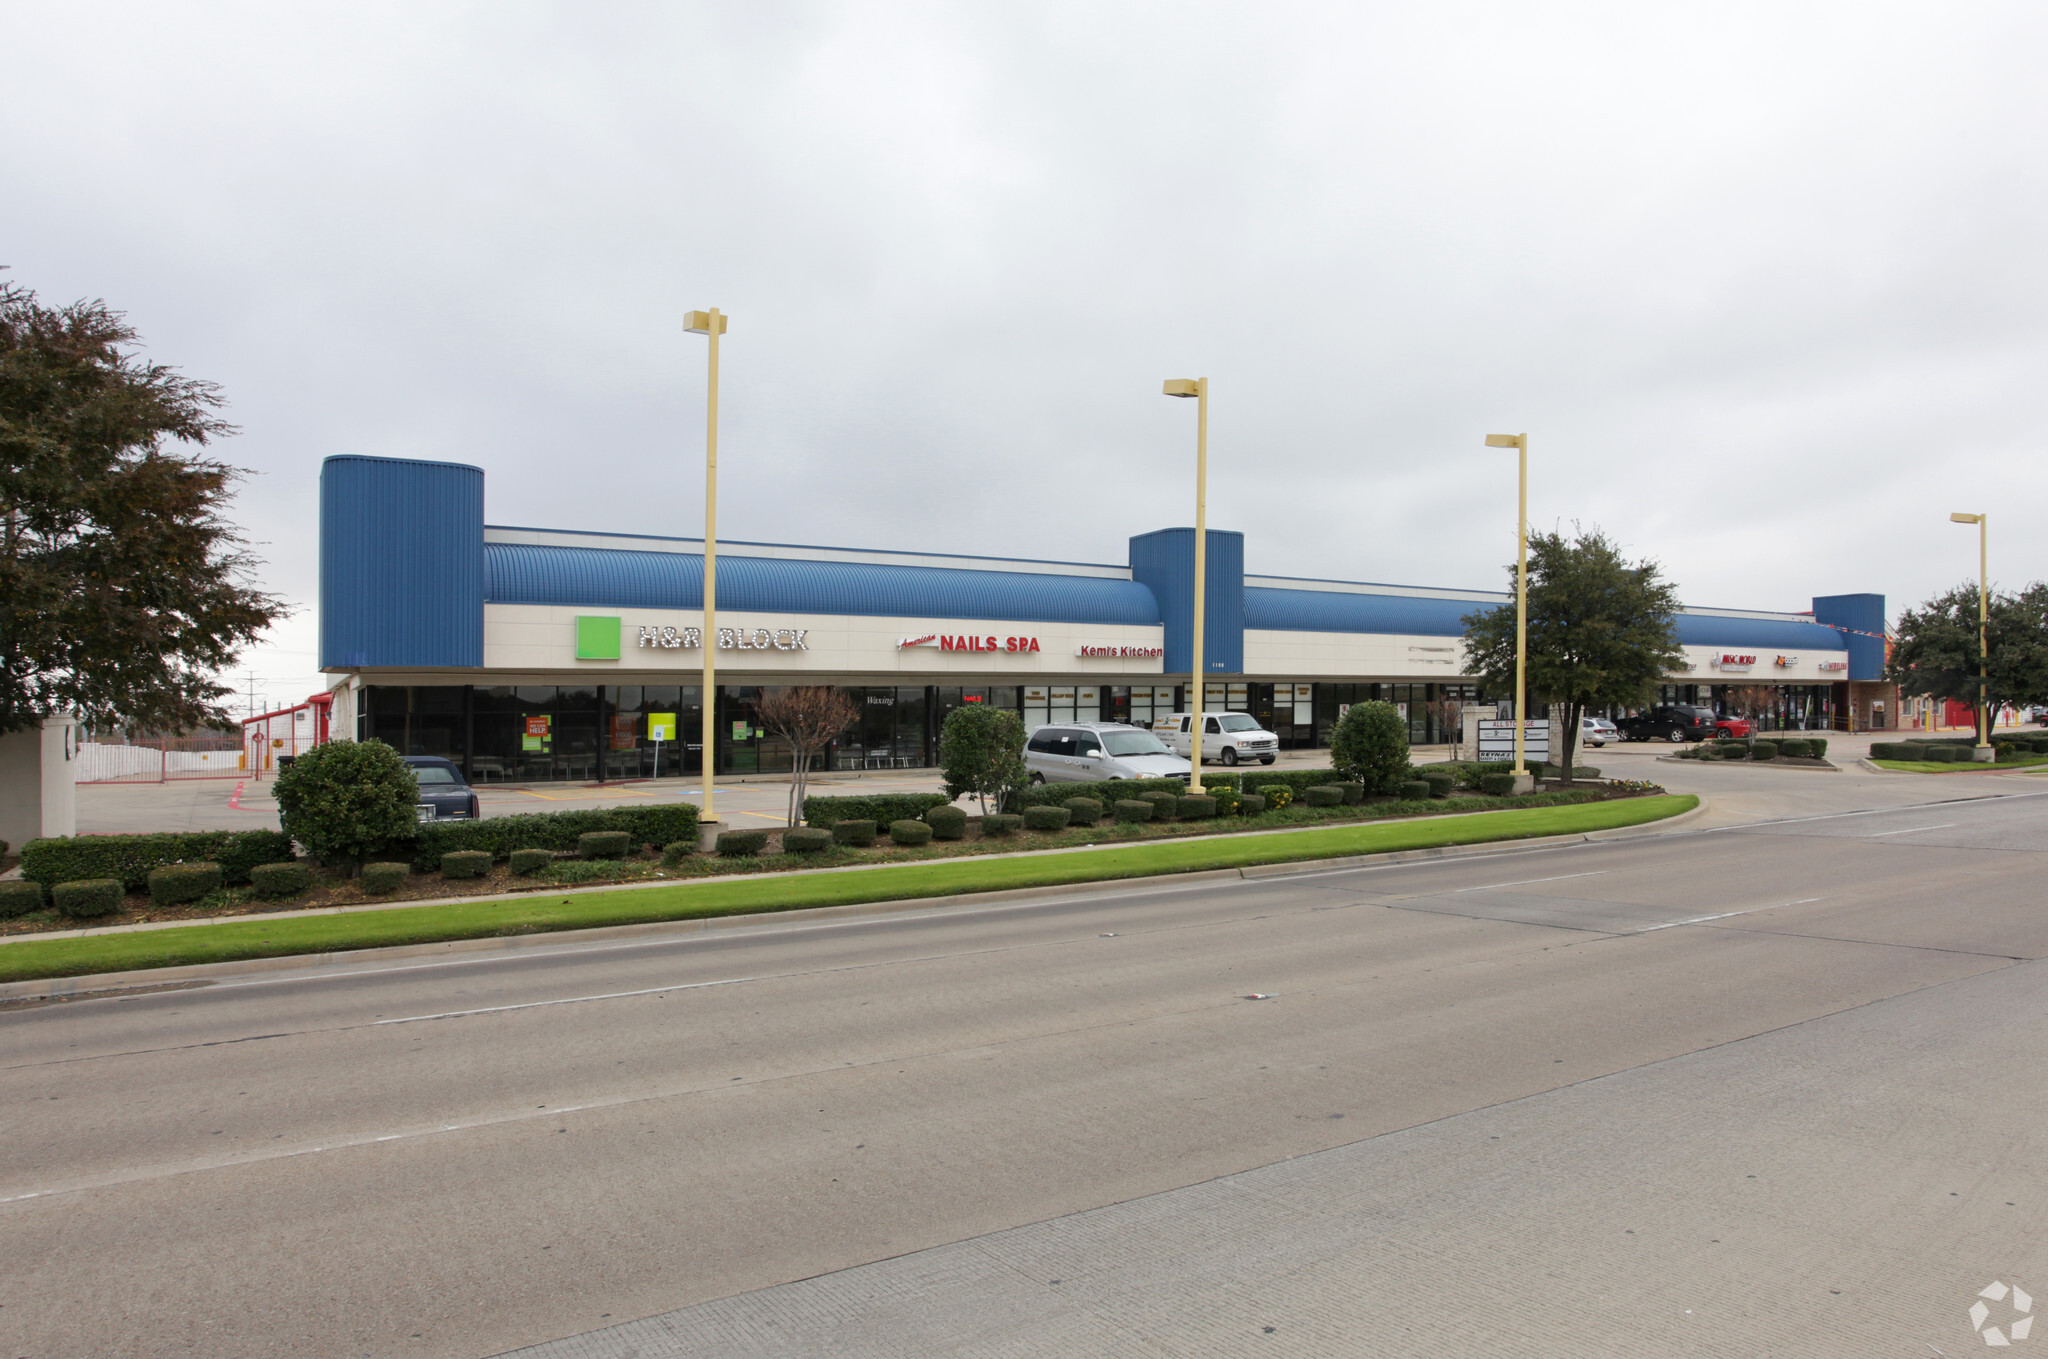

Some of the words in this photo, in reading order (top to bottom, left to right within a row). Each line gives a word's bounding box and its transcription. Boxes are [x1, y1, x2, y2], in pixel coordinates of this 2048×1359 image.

[638, 626, 703, 649] H&R
[718, 628, 809, 650] BLOCK
[900, 634, 936, 650] American
[940, 635, 998, 652] NAILS
[1005, 636, 1041, 652] SPA
[1081, 645, 1118, 657] Kemi's
[1120, 646, 1163, 657] Kitchen
[867, 696, 895, 706] Waxing
